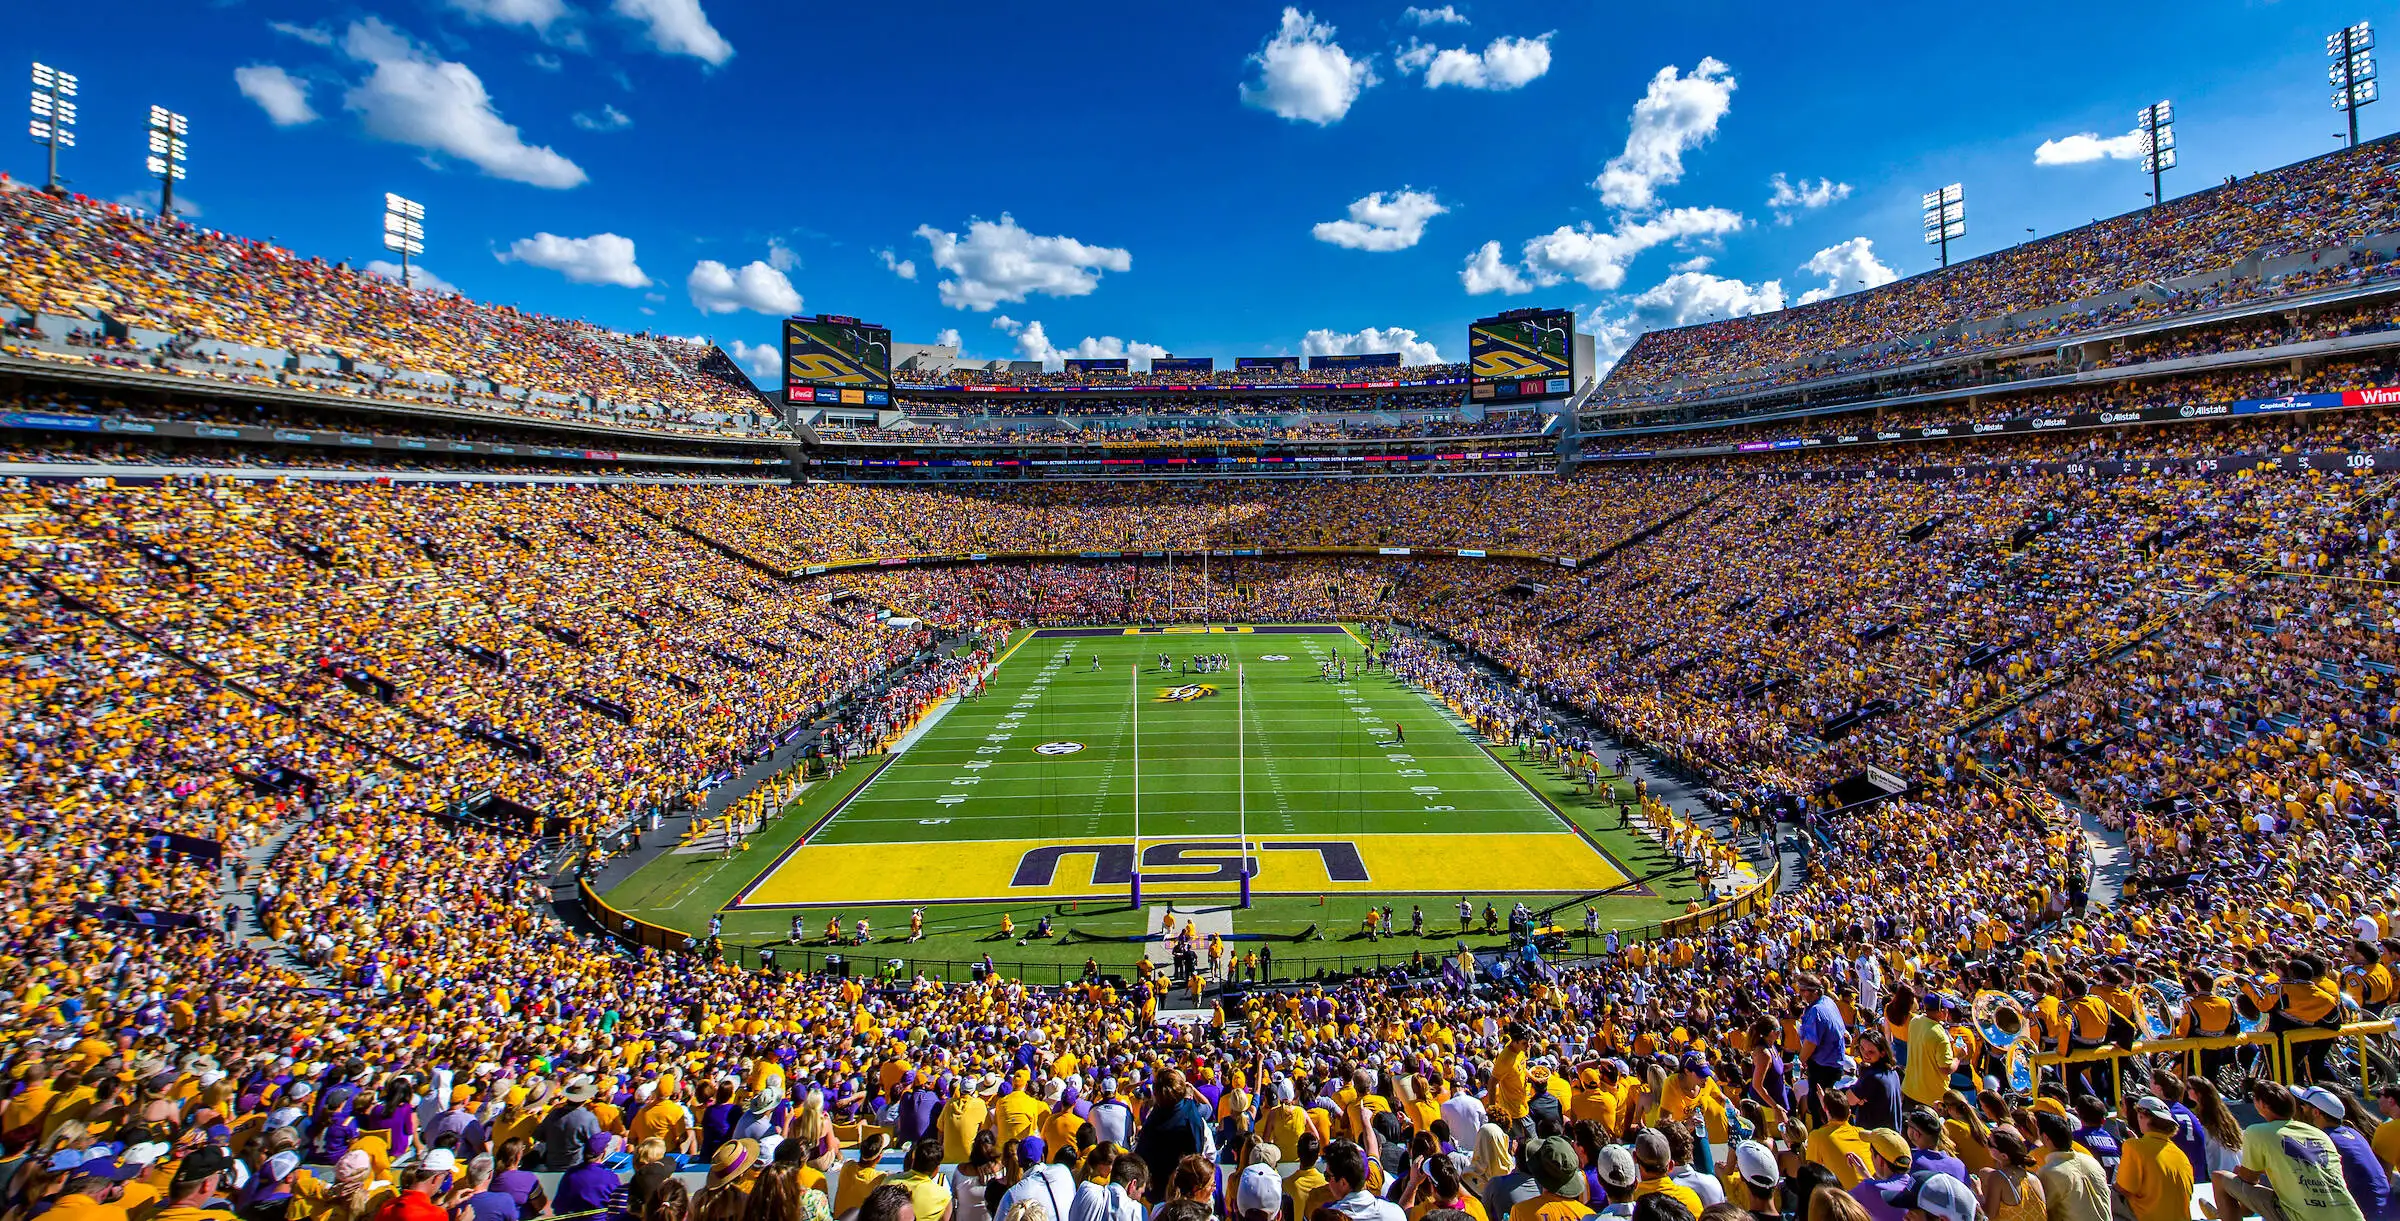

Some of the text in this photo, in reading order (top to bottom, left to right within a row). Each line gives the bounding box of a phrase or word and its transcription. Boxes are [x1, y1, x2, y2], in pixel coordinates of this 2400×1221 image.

[2360, 391, 2400, 404] Winn
[2195, 405, 2227, 416] Allstate
[2259, 402, 2284, 410] Capital
[2113, 412, 2140, 421] Allstate
[2043, 419, 2066, 427] Allstate
[2196, 459, 2217, 470] 105
[2346, 455, 2375, 467] 106
[1953, 468, 1965, 476] 103
[2067, 464, 2084, 474] 104
[1410, 786, 1442, 795] 10
[936, 794, 968, 803] 10
[1009, 841, 1371, 888] LSU
[2174, 1114, 2195, 1141] 7
[2304, 1198, 2327, 1208] LSU
